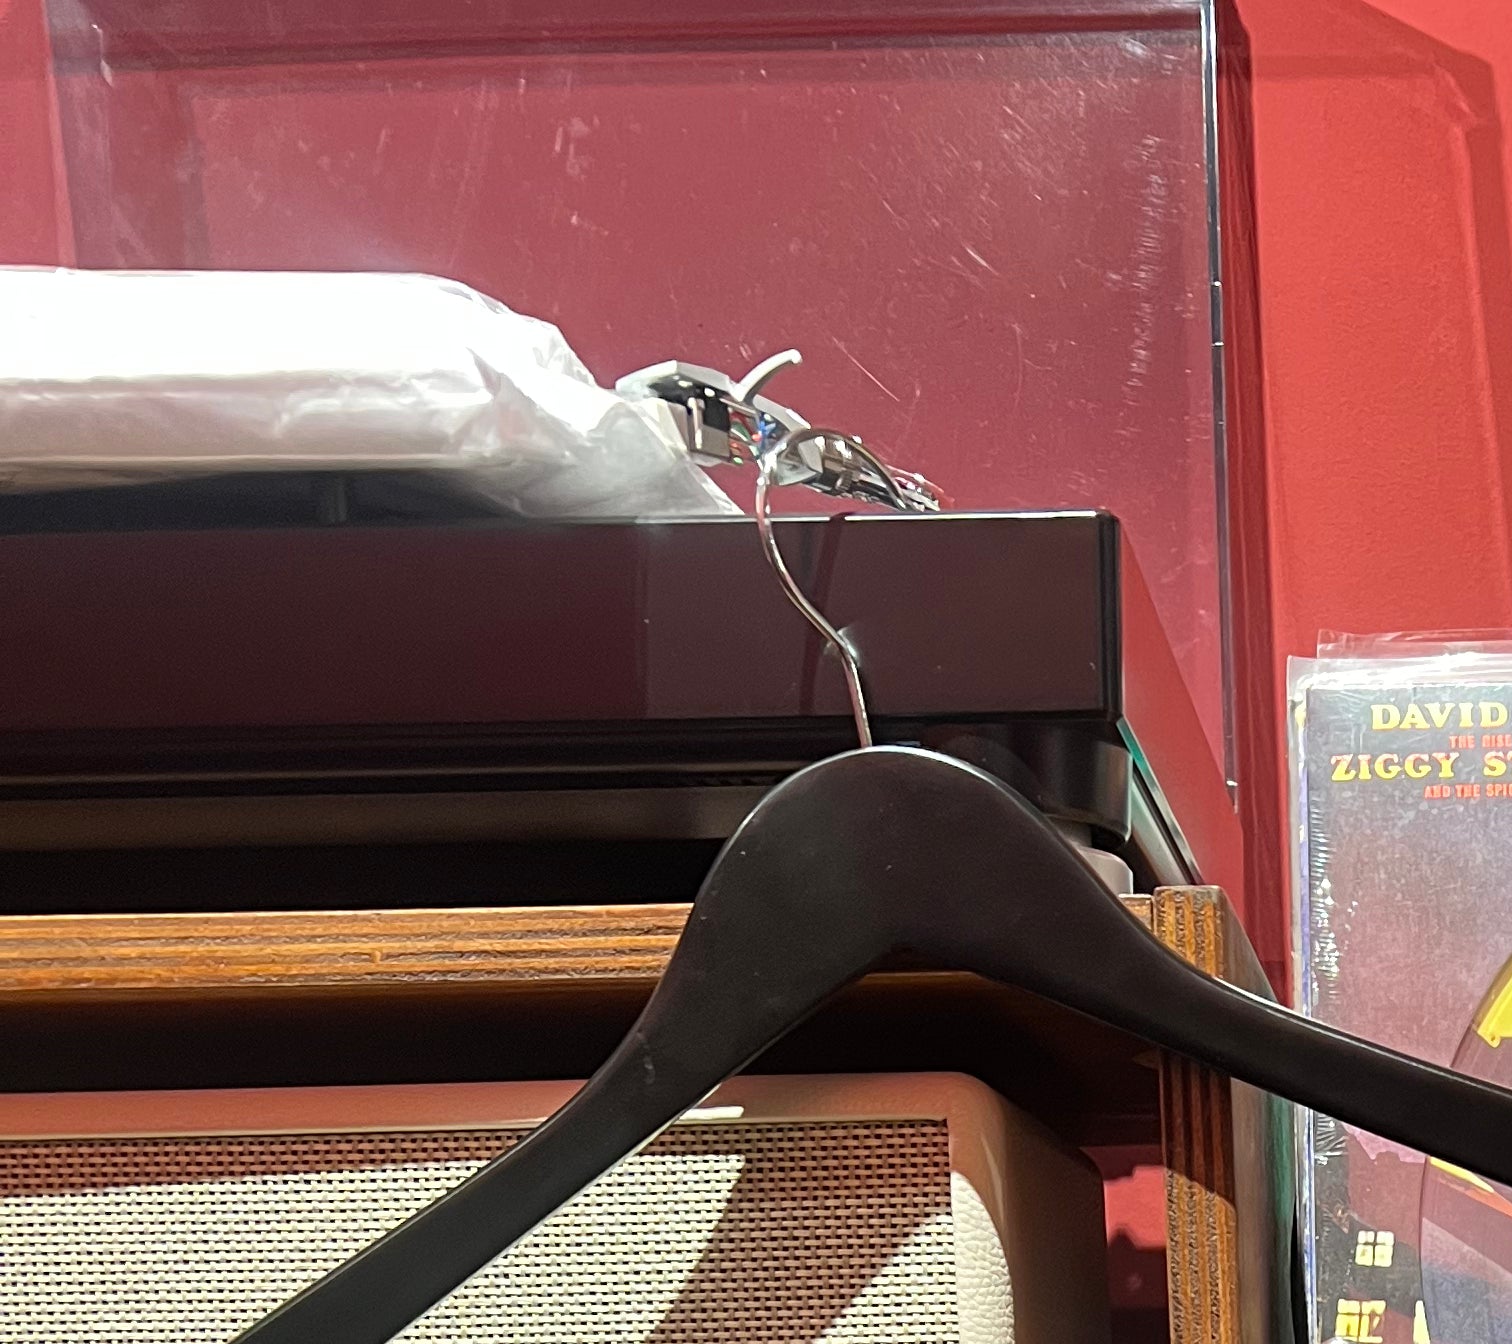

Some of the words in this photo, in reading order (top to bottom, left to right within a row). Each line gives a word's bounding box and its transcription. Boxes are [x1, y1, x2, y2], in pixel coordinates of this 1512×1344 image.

[1371, 701, 1508, 730] DAVID
[1449, 735, 1475, 748] THE
[1481, 734, 1512, 748] RISE
[1331, 751, 1460, 781] ZIGGY
[1424, 784, 1451, 799] AND
[1455, 783, 1481, 798] THE
